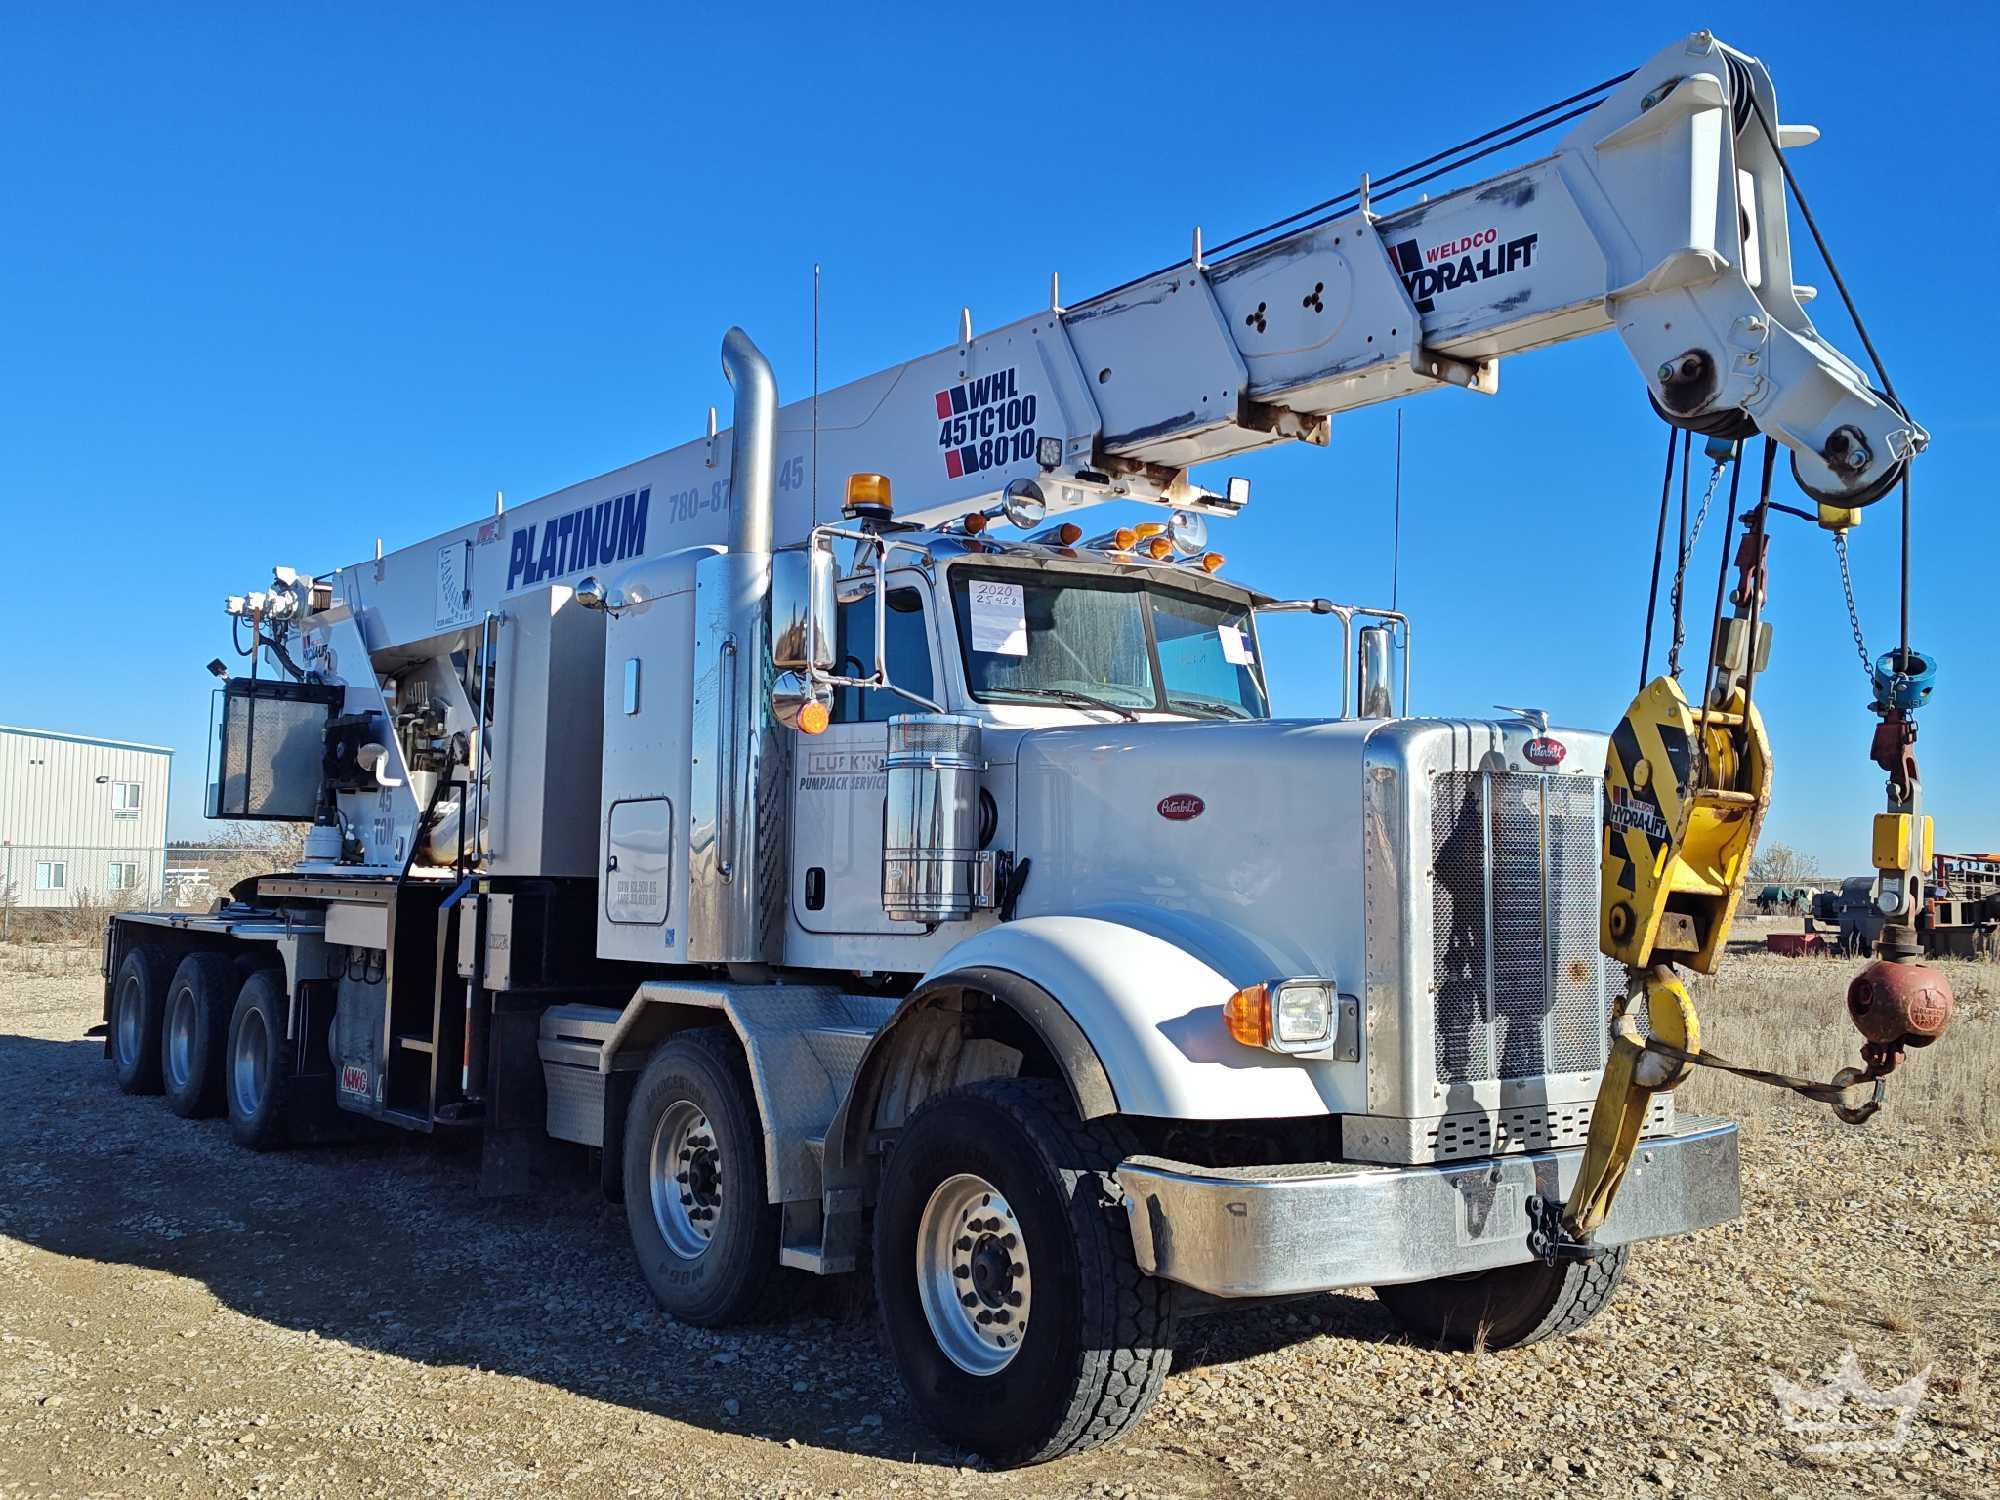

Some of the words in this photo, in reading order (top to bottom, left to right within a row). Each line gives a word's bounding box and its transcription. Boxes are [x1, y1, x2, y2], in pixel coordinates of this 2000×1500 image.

[1426, 228, 1497, 263] WELDCO
[1400, 233, 1538, 299] YDRA-LIFT
[969, 368, 1018, 409] WHL
[939, 394, 1037, 448] 45TC100
[979, 428, 1036, 471] 8010
[506, 487, 651, 591] PLATINUM
[978, 584, 1013, 597] 2020
[799, 777, 848, 791] PUMPJACK
[1161, 800, 1199, 814] Peterbilt
[1610, 804, 1666, 837] HYDRA-LIFT
